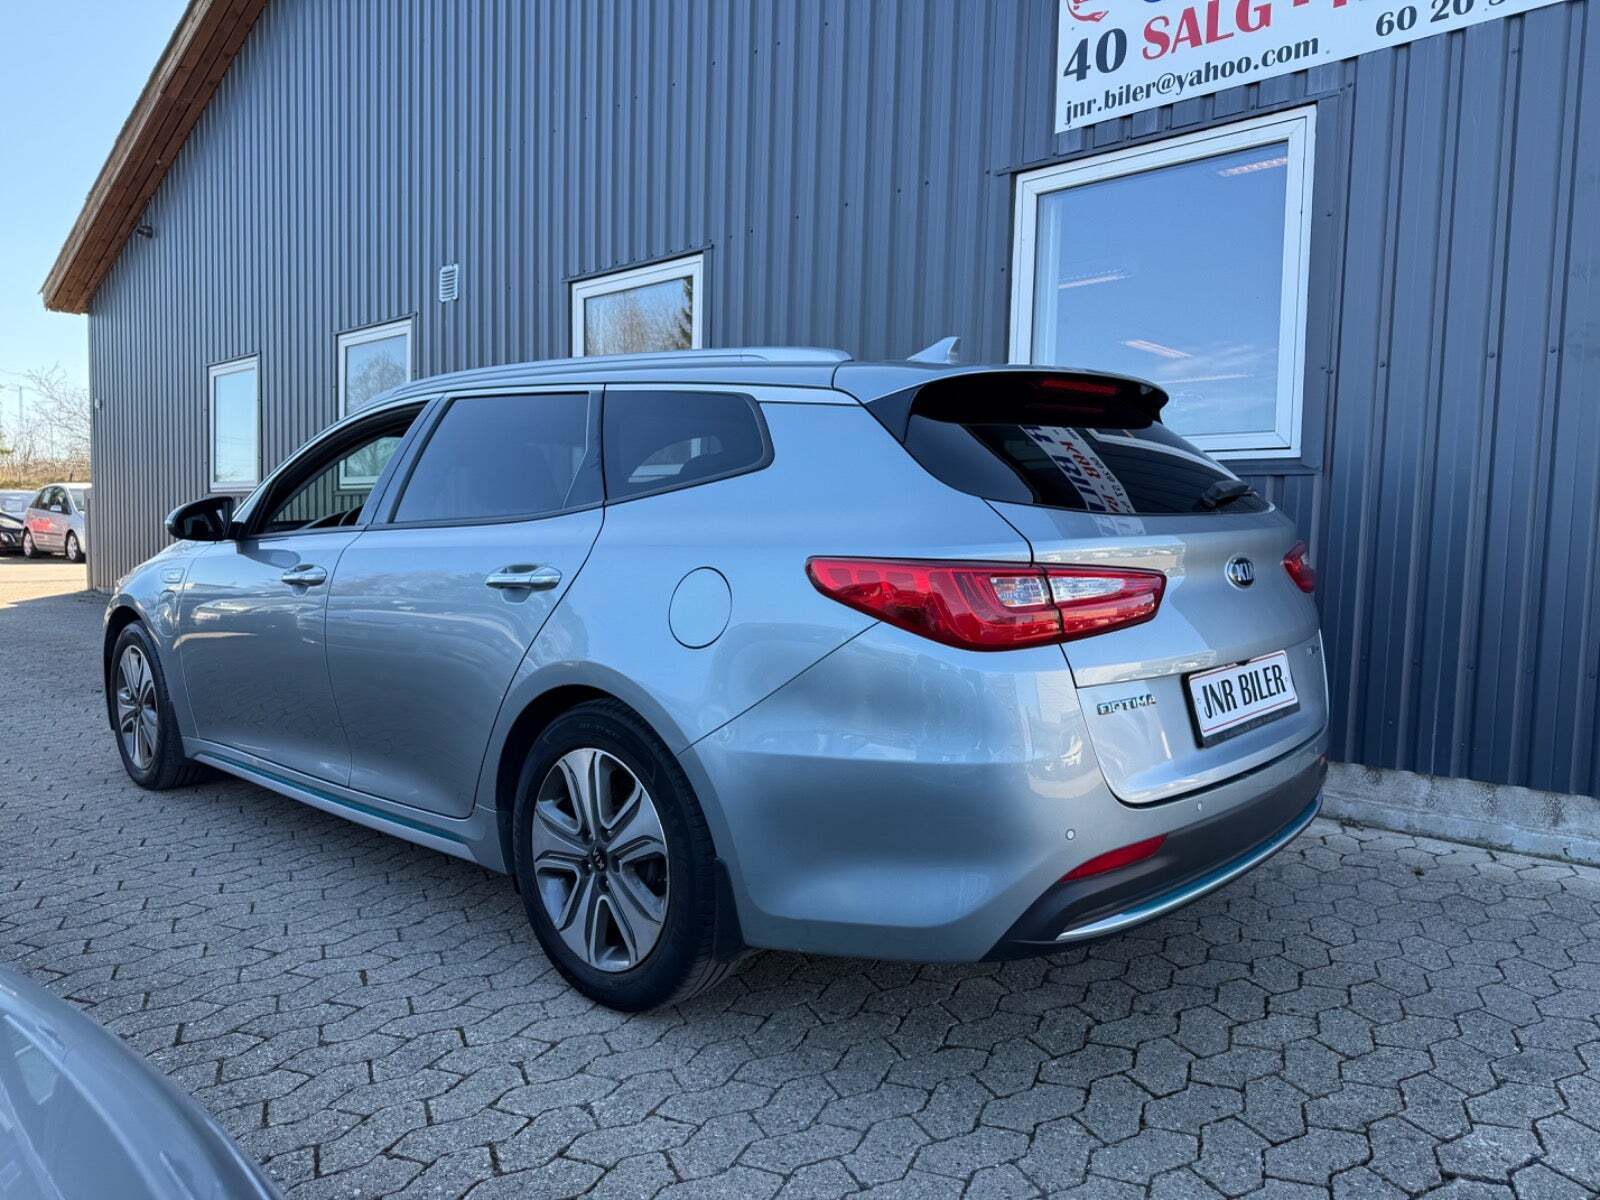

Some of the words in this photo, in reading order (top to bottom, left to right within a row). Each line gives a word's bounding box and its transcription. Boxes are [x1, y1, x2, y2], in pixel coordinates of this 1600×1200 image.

[1063, 27, 1127, 82] 40
[1142, 0, 1272, 60] SALG
[1375, 5, 1418, 37] 60
[1430, 0, 1474, 23] 20
[1064, 36, 1319, 126] jnr.biler@yahoo.com
[1202, 678, 1237, 719] JNR
[1238, 664, 1287, 706] BILER
